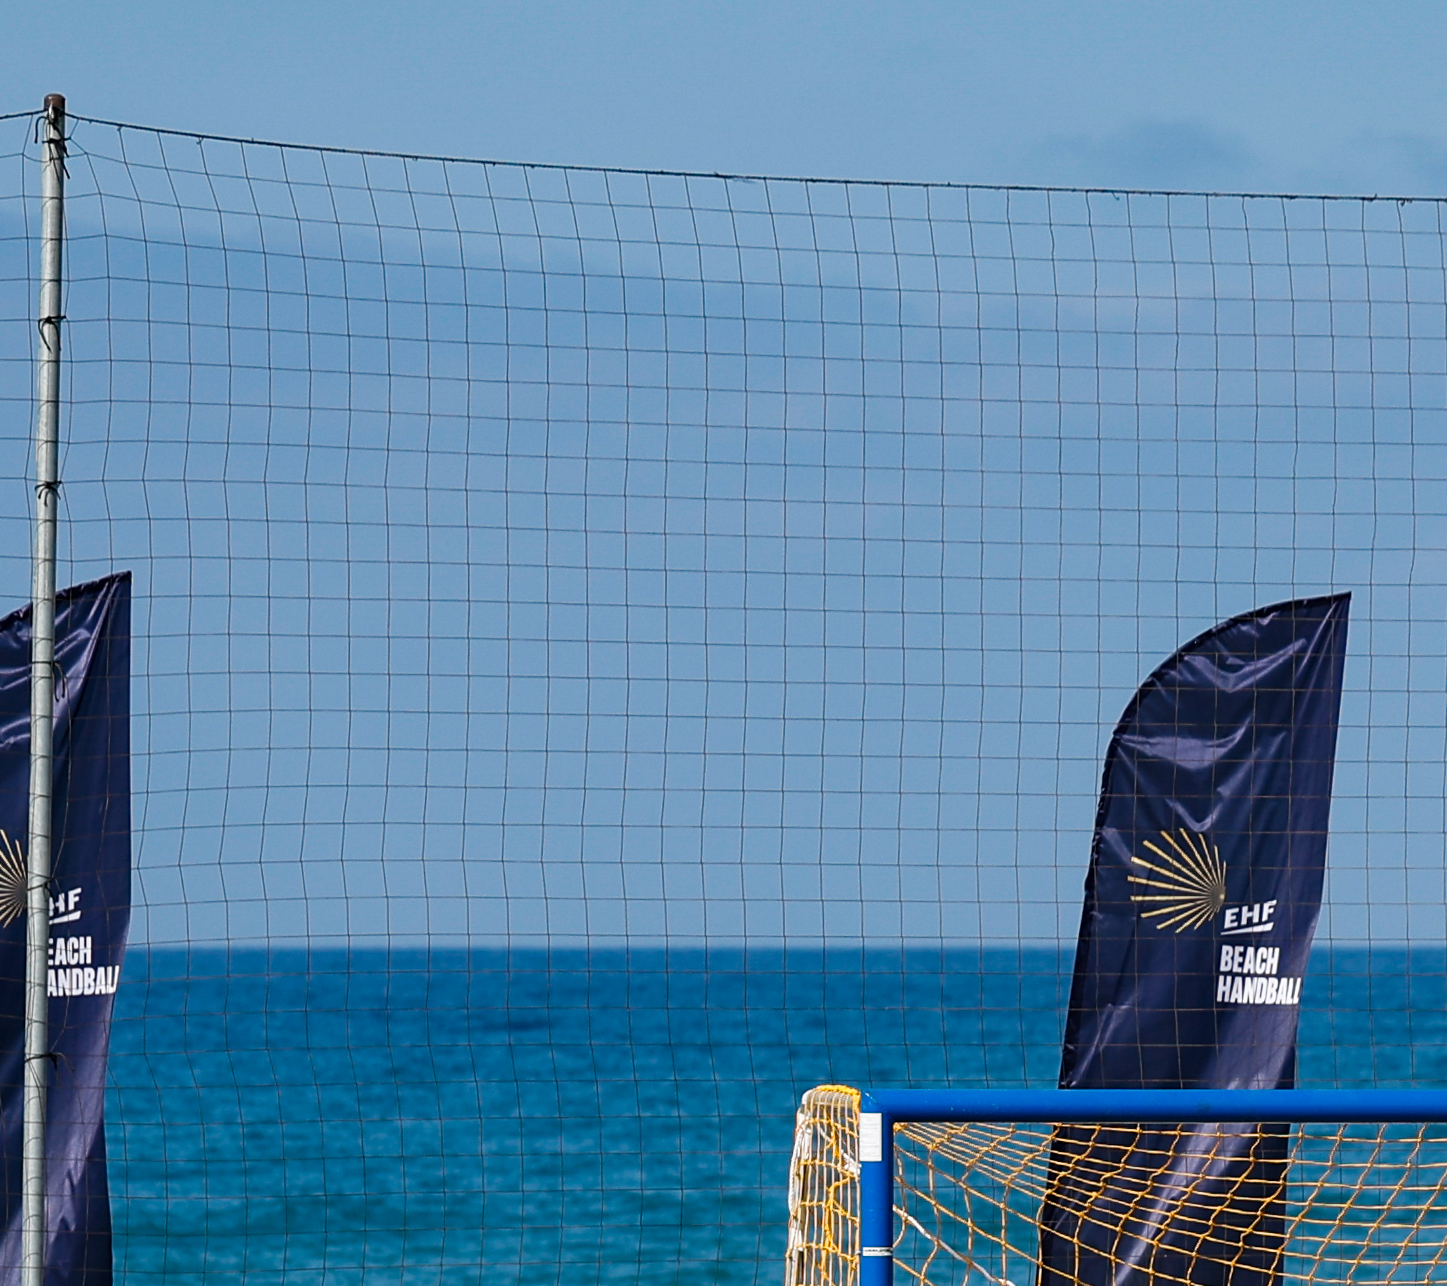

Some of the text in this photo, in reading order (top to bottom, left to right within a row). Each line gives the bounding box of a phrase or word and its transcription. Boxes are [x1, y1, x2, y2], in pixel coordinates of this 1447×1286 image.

[49, 887, 82, 917] HF
[1224, 900, 1277, 929] EHF
[48, 935, 92, 965] EACH
[1220, 945, 1280, 975] BEACH
[47, 965, 119, 998] ANDBALL
[1217, 975, 1301, 1005] HANDBALL
